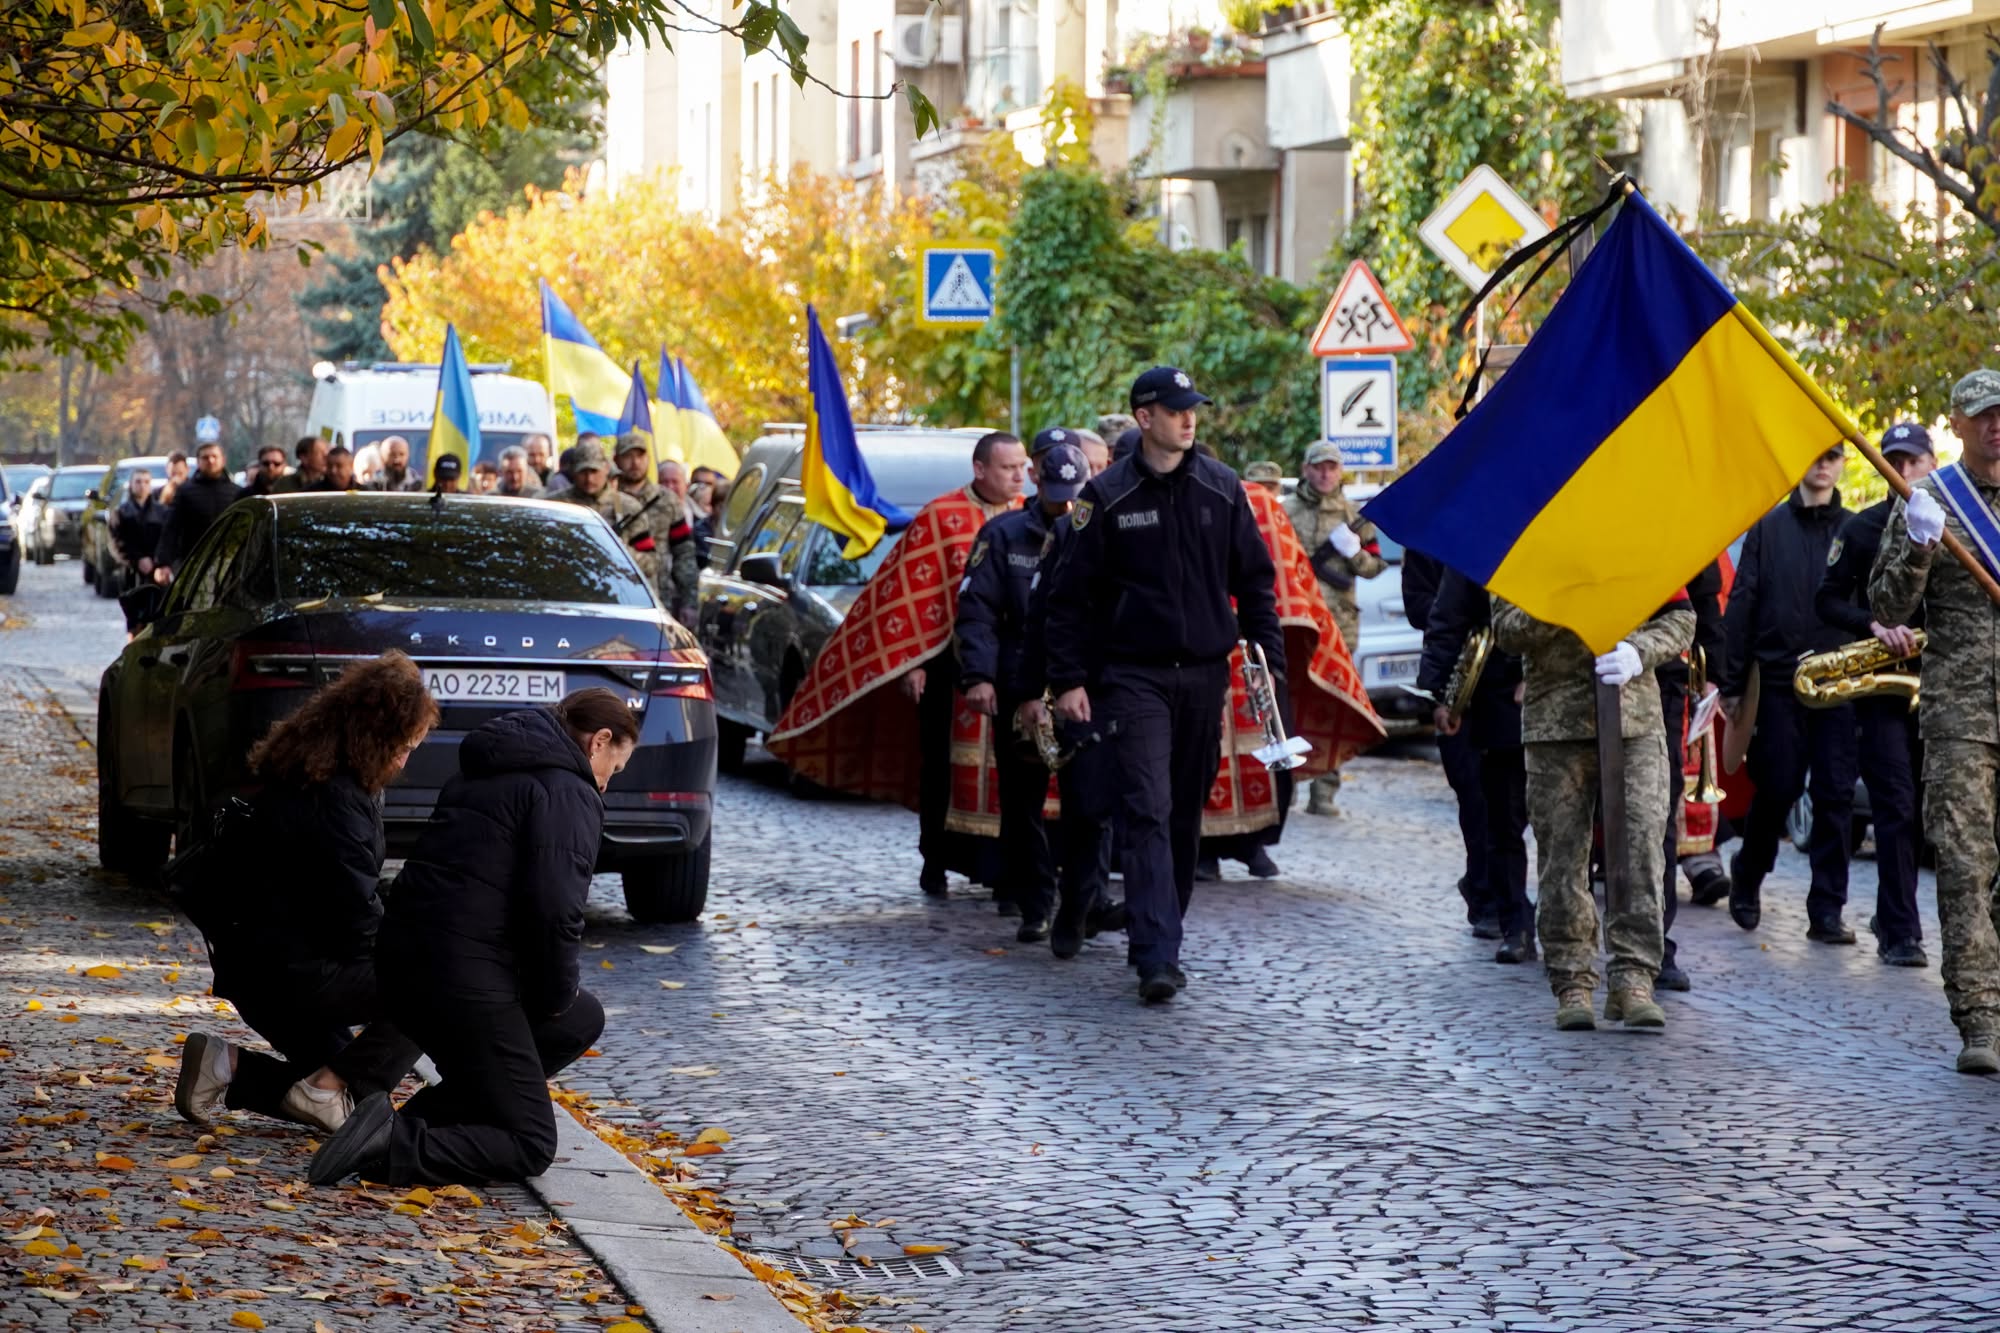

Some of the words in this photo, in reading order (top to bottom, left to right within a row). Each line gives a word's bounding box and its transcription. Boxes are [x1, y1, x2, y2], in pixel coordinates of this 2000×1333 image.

[1117, 510, 1159, 528] ПОЛІЦІЯ
[410, 632, 571, 648] ŠKODA
[429, 673, 460, 695] AO
[466, 673, 520, 696] 2232
[527, 675, 561, 697] EM
